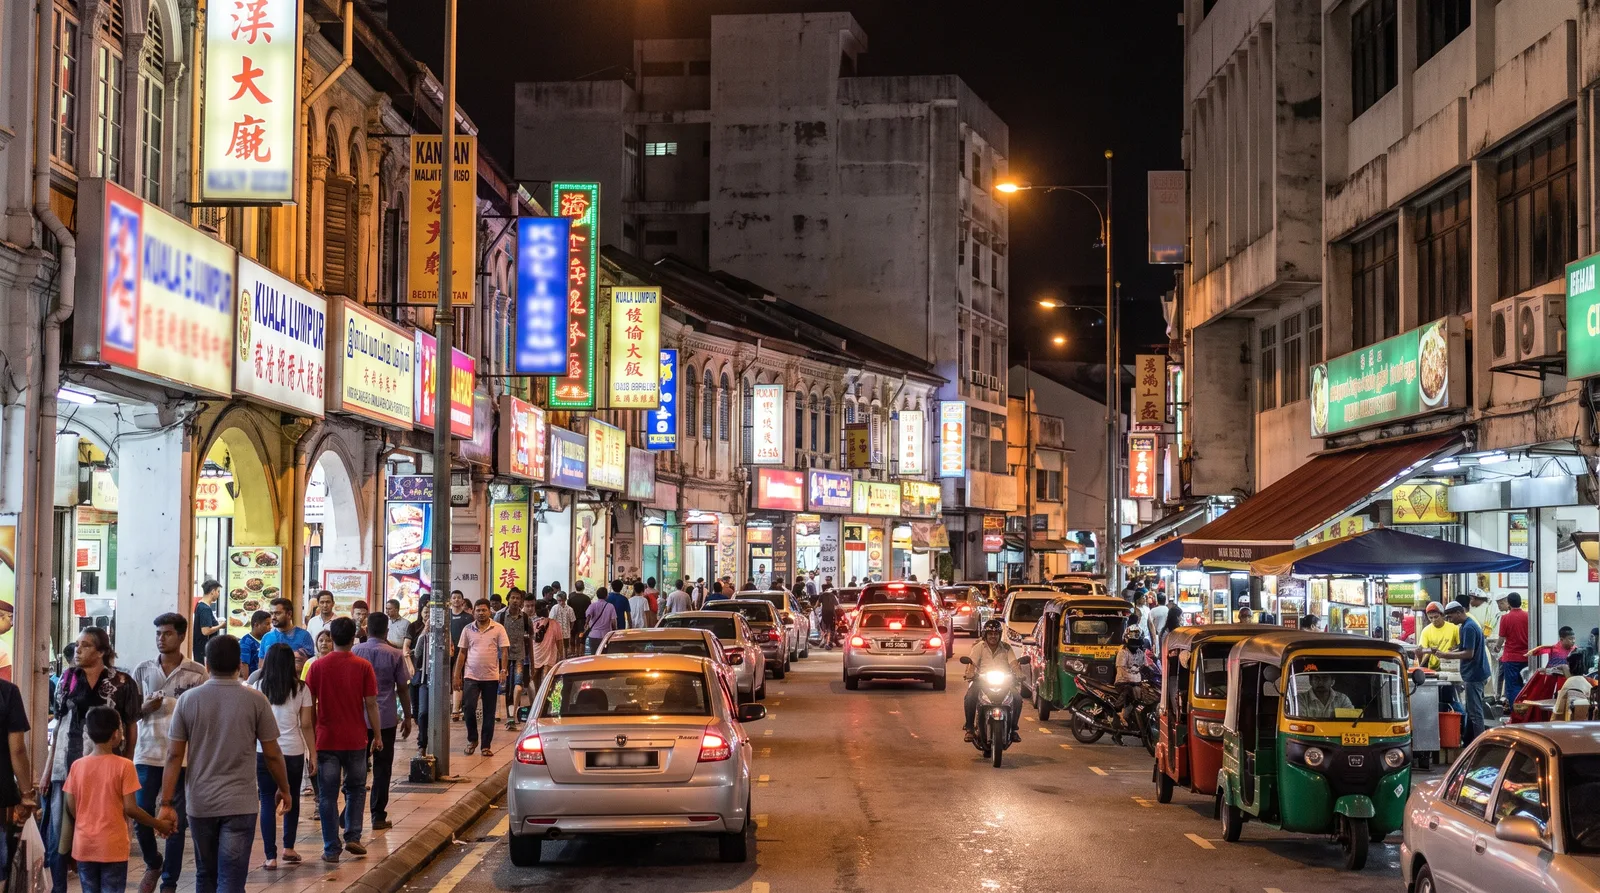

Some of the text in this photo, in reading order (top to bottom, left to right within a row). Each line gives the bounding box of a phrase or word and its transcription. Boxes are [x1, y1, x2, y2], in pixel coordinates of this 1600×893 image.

[255, 280, 286, 335] KUALA
[289, 297, 324, 351] LUMPUR
[616, 292, 656, 303] KUALA LUMPUR
